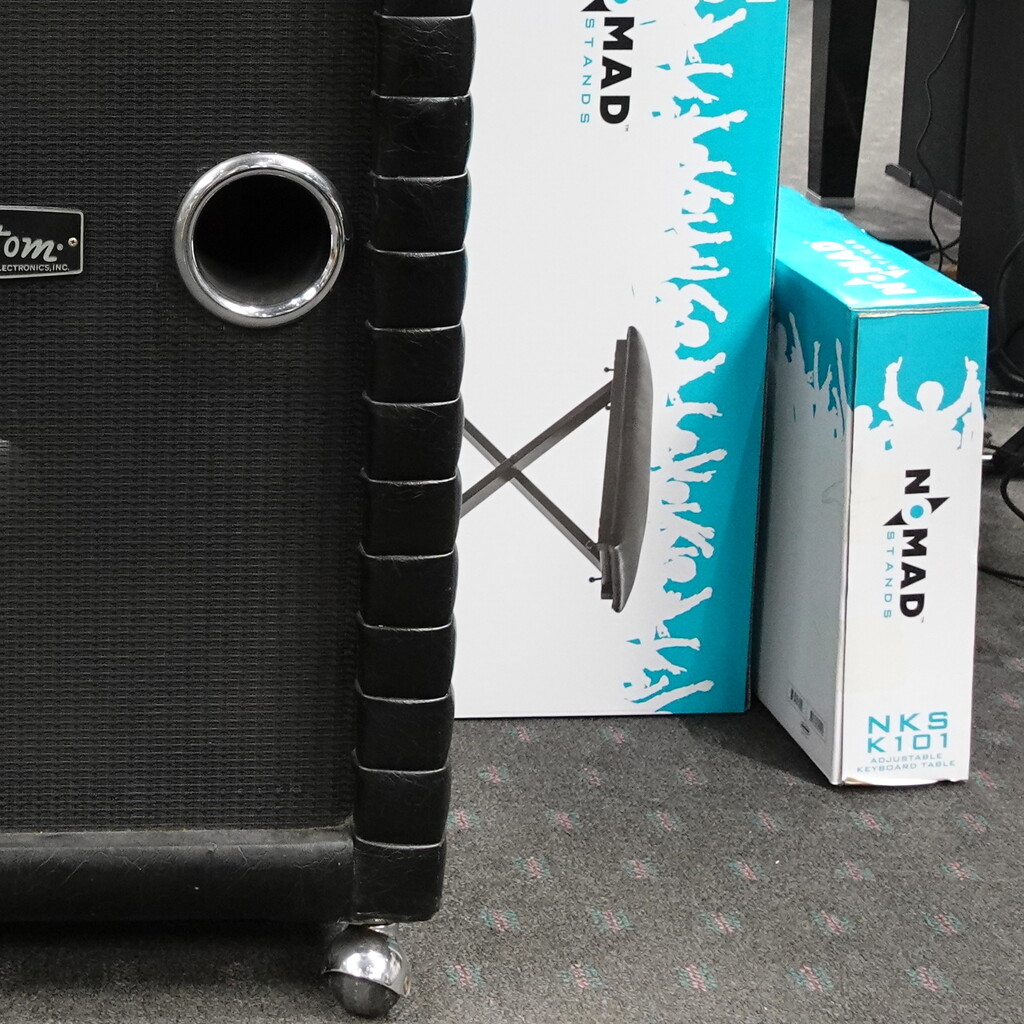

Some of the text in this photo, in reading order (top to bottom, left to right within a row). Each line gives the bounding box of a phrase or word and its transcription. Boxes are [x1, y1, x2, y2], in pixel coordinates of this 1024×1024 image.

[579, 17, 595, 124] STANDS
[899, 468, 931, 618] NOMAD
[883, 530, 895, 619] STANDS
[867, 711, 948, 734] NKS
[867, 733, 948, 753] K101
[856, 759, 956, 773] KEYBOARD TABLE
[870, 752, 943, 764] ADJUSTABLE
